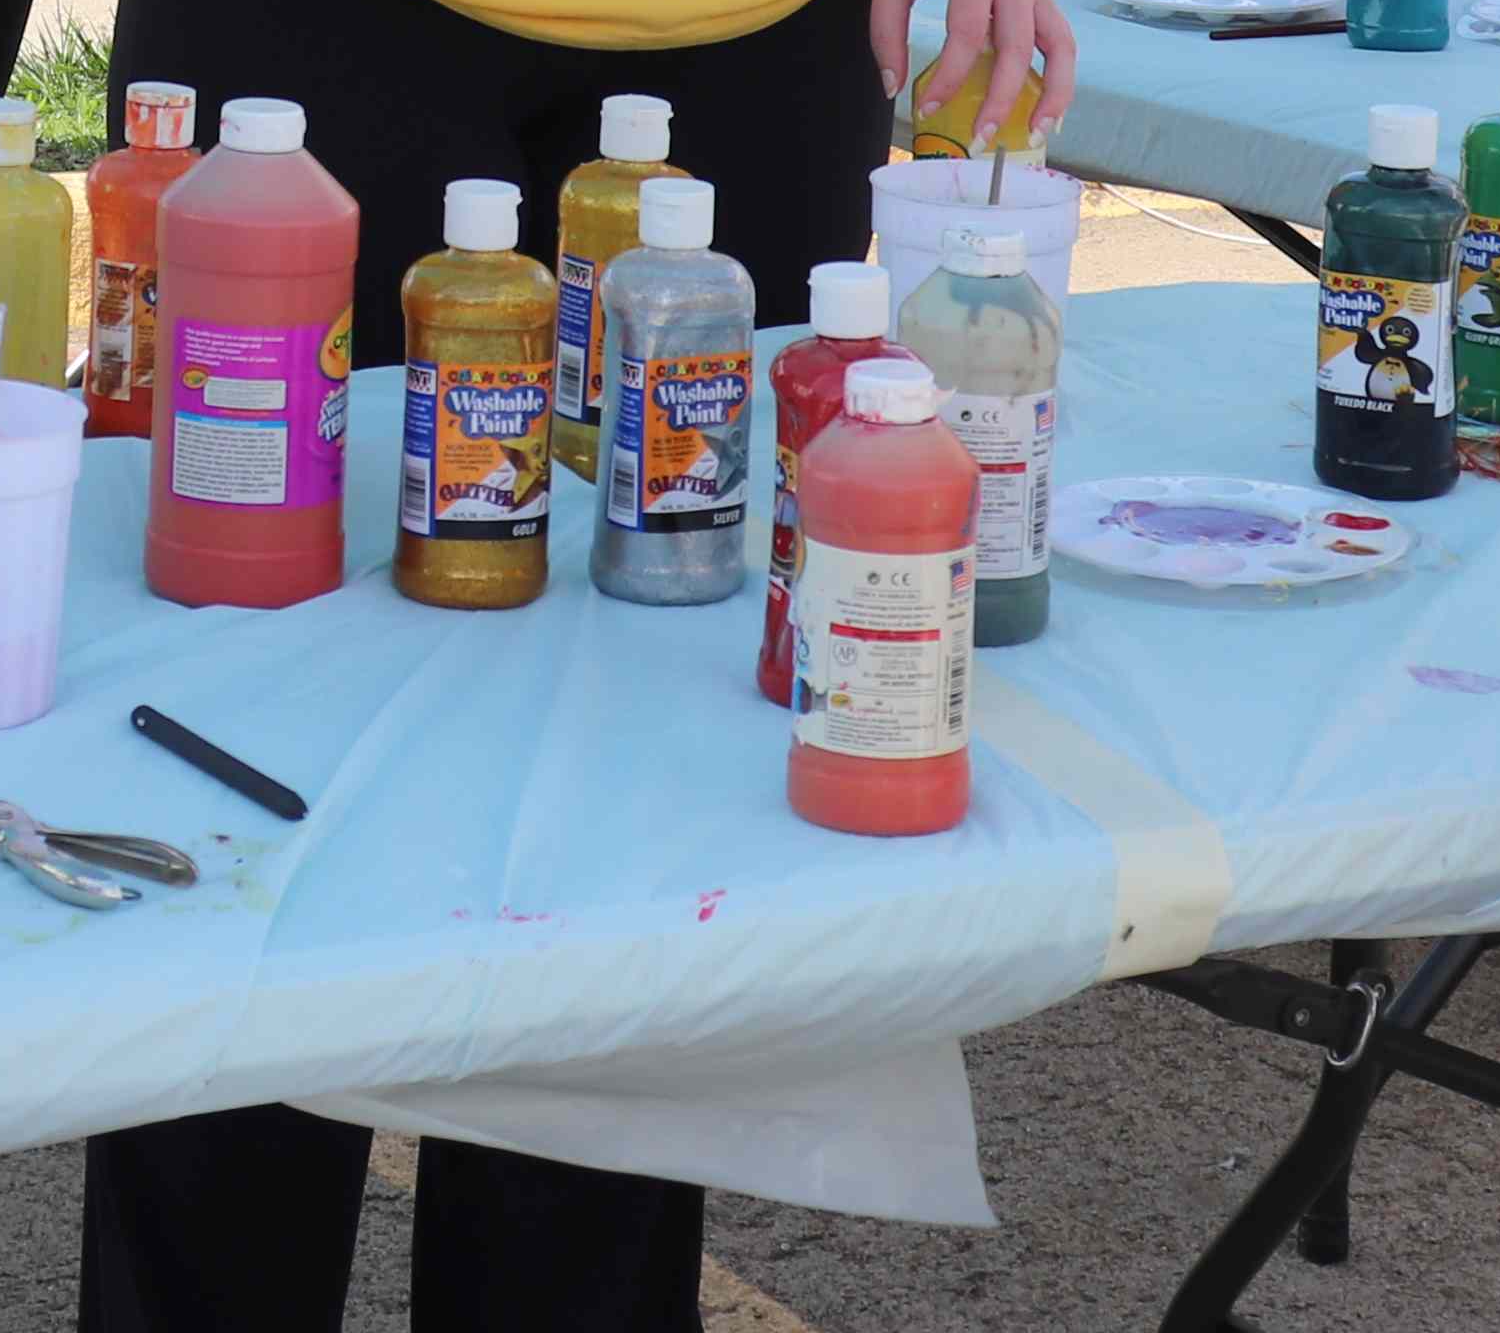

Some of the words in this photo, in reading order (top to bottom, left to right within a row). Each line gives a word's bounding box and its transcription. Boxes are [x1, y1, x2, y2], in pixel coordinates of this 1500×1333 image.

[1325, 307, 1364, 328] Paint
[450, 390, 543, 412] Washable
[658, 378, 744, 405] Washable
[676, 402, 725, 425] Paint
[1367, 399, 1395, 413] BLACK
[470, 413, 524, 434] Paint
[439, 483, 516, 506] GLITTER
[512, 523, 538, 536] GOLD
